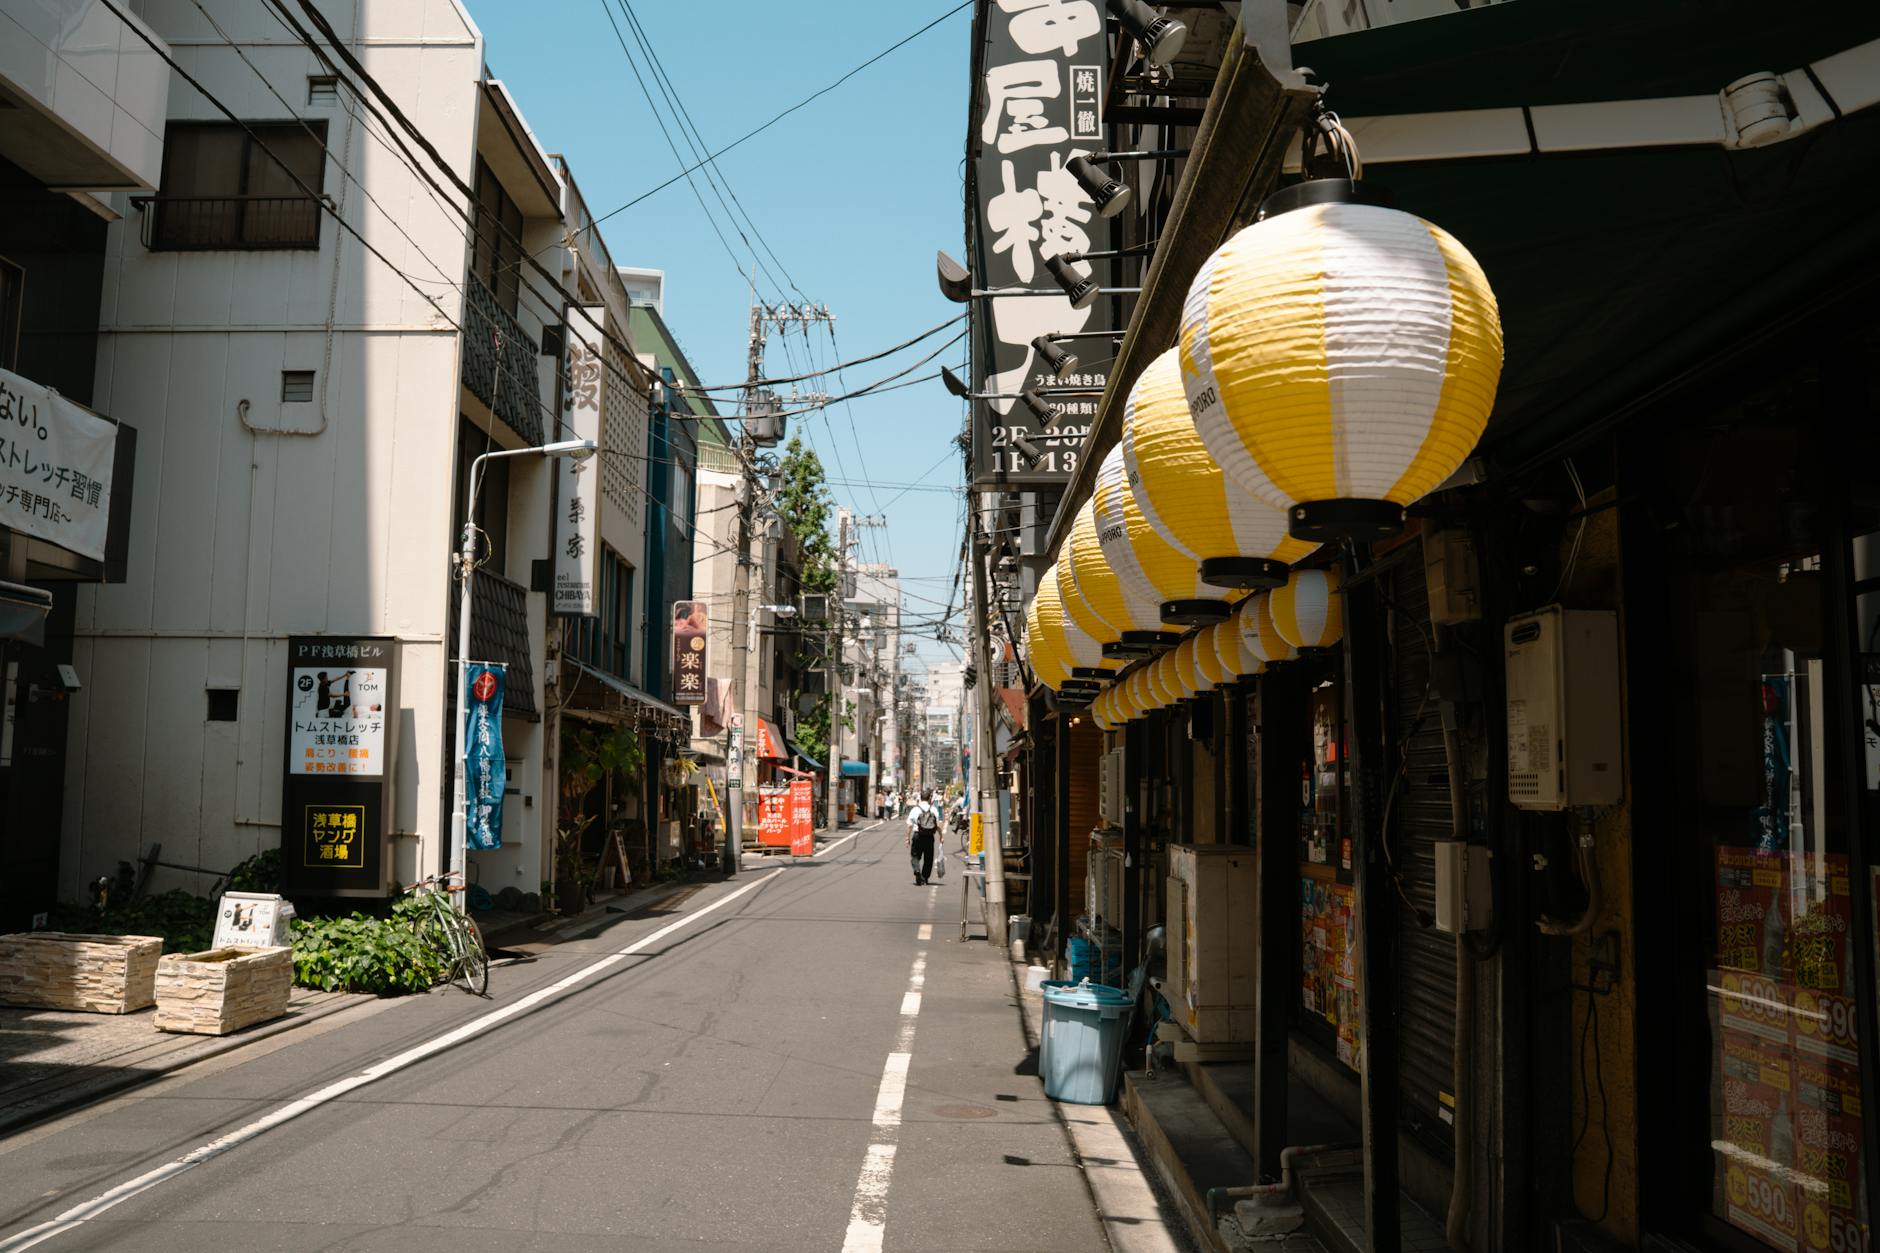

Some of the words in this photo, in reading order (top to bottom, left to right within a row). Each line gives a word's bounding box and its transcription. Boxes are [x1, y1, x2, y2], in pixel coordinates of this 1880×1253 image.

[1076, 70, 1097, 135] 焼一徹
[564, 342, 600, 412] 鰻
[1035, 373, 1106, 387] うまい焼き鳥
[991, 426, 1028, 447] 2F
[991, 452, 1025, 473] 1F
[555, 590, 591, 601] CHIBAYA
[679, 652, 700, 691] 楽楽
[299, 677, 312, 688] 2F
[358, 683, 379, 692] TOM
[295, 721, 382, 733] トムストレッチ
[314, 734, 360, 746] 浅草橋店
[313, 812, 357, 829] 浅草橋
[312, 829, 356, 844] ヤング
[319, 845, 349, 860] 酒場
